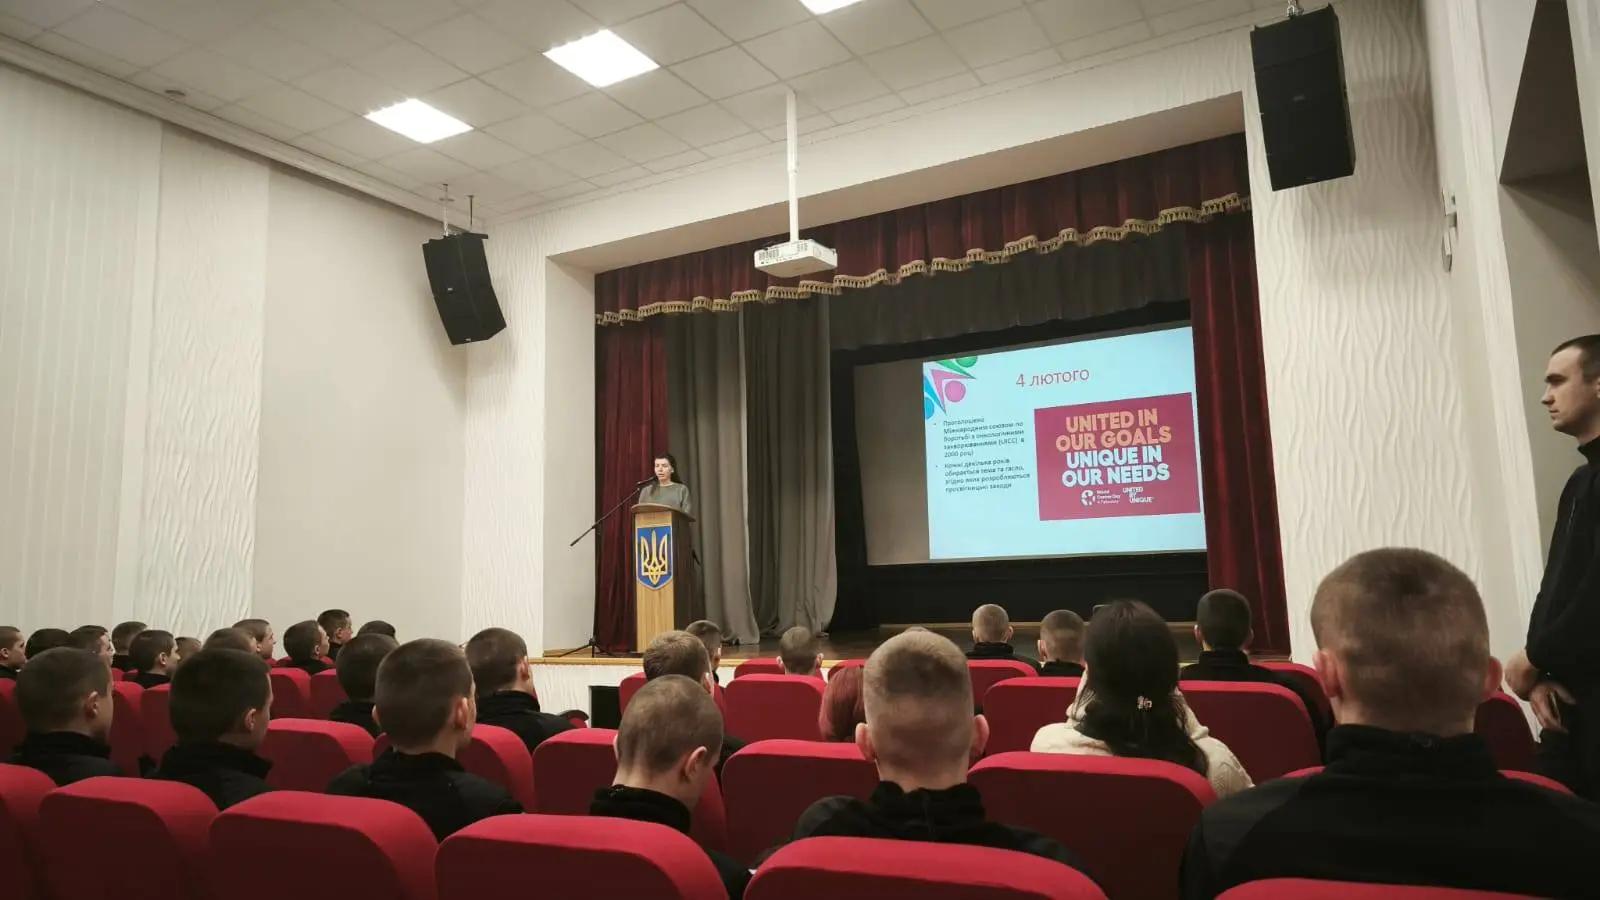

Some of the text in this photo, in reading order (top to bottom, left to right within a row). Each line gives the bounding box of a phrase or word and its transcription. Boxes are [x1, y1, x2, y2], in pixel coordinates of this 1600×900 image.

[1016, 369, 1090, 387] 4 лютого
[1065, 408, 1158, 433] UNITED IN
[1055, 426, 1172, 451] OUR GOALS
[944, 450, 959, 458] 2000
[1066, 444, 1163, 468] UNIQUE IN
[1061, 464, 1170, 487] OUR NEEDS
[1129, 496, 1153, 504] UNIQUE
